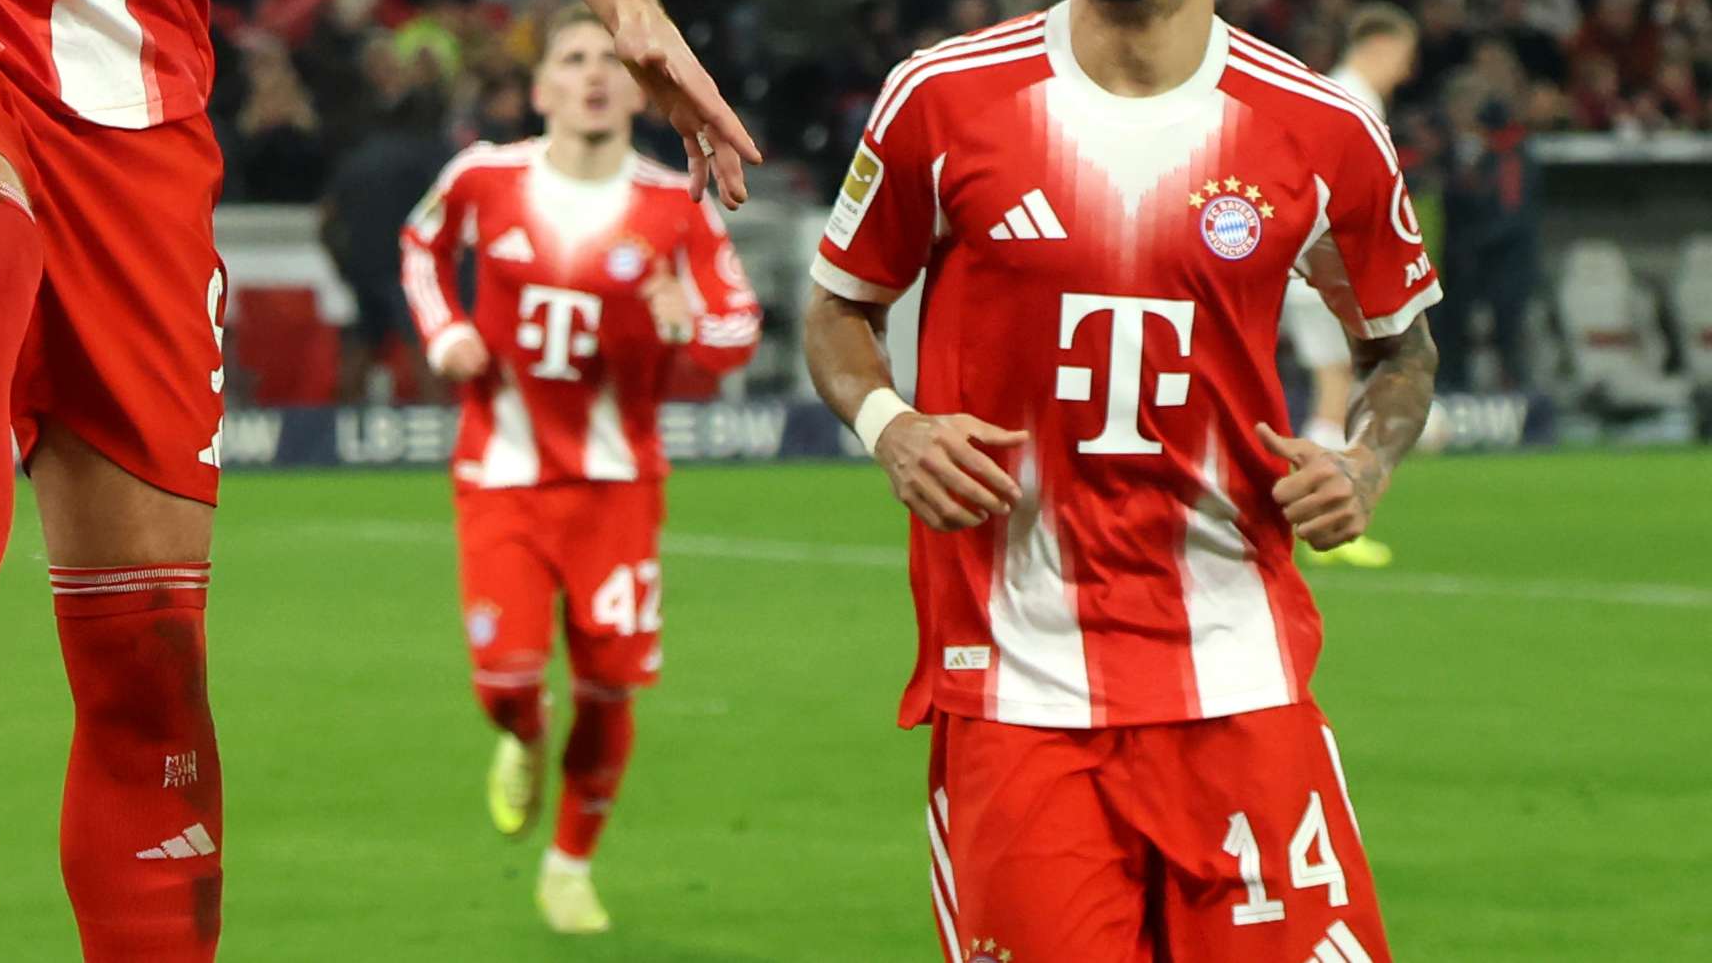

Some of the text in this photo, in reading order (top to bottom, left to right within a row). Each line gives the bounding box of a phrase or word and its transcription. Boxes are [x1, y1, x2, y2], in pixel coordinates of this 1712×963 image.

[517, 283, 603, 382] T
[1055, 292, 1195, 455] T
[1222, 790, 1350, 926] 14
